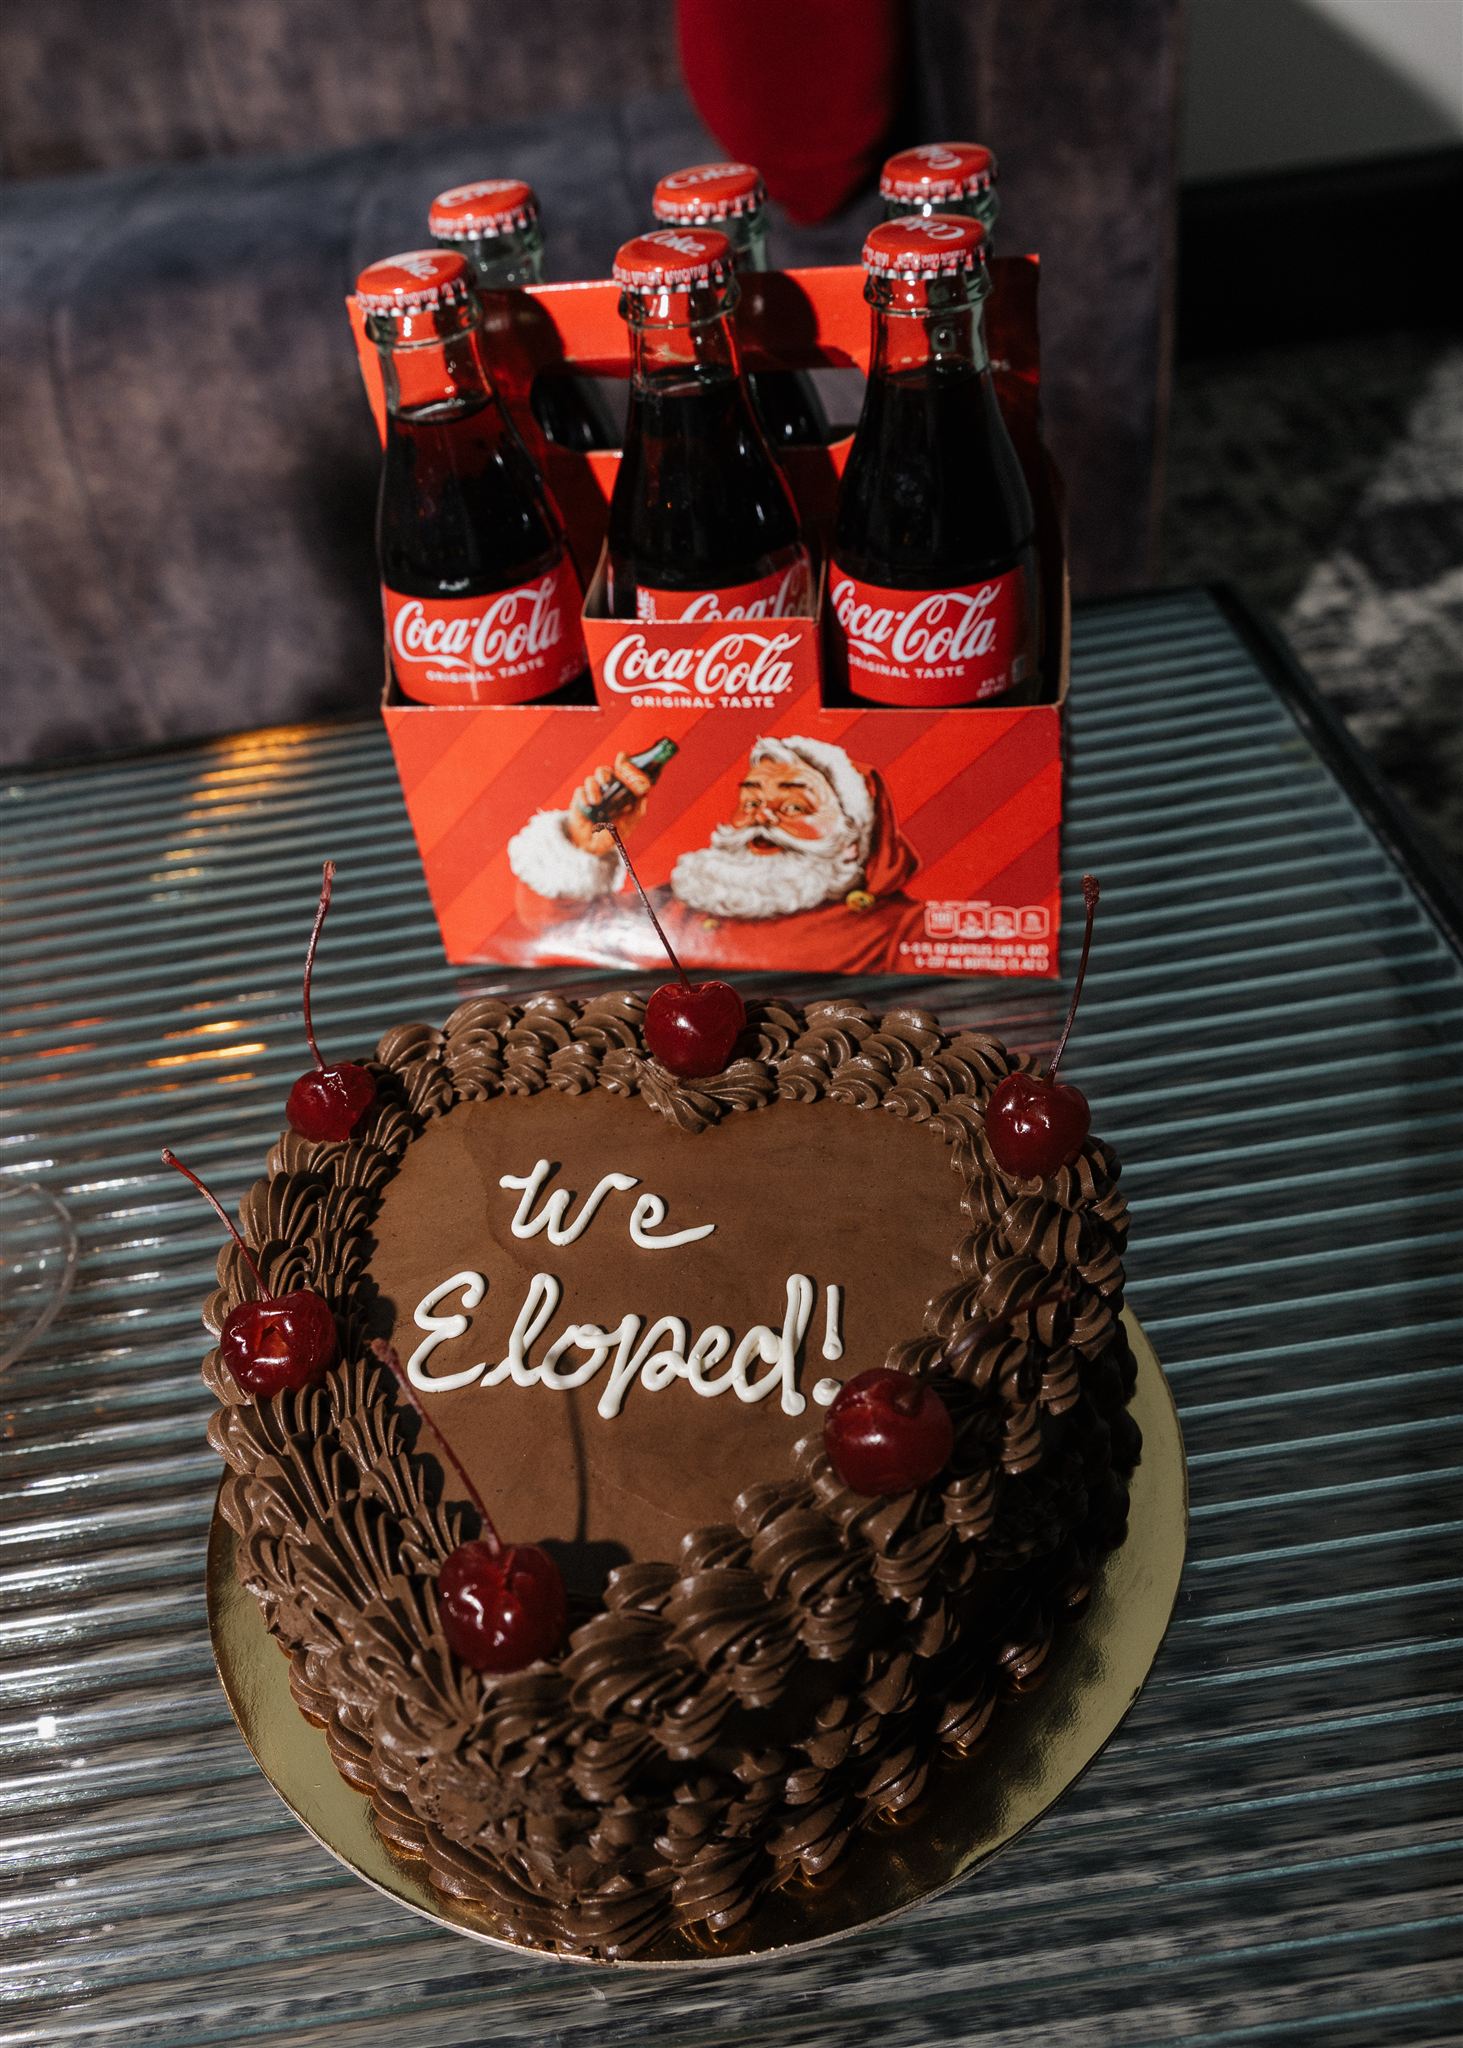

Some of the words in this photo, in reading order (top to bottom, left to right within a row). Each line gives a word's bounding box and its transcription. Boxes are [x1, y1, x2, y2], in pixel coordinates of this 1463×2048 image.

[394, 577, 563, 668] Coca-Cola
[831, 579, 1001, 663] Coca-Cola
[426, 669, 495, 684] ORIGINAL
[499, 656, 545, 678] TASTE
[603, 632, 803, 694] Coca-Cola
[847, 653, 911, 679] ORIGINAL
[913, 664, 966, 680] TASTE
[630, 695, 716, 709] ORIGINAL
[719, 695, 776, 709] TASTE
[499, 1158, 716, 1250] We
[406, 1270, 842, 1420] Eloped!
